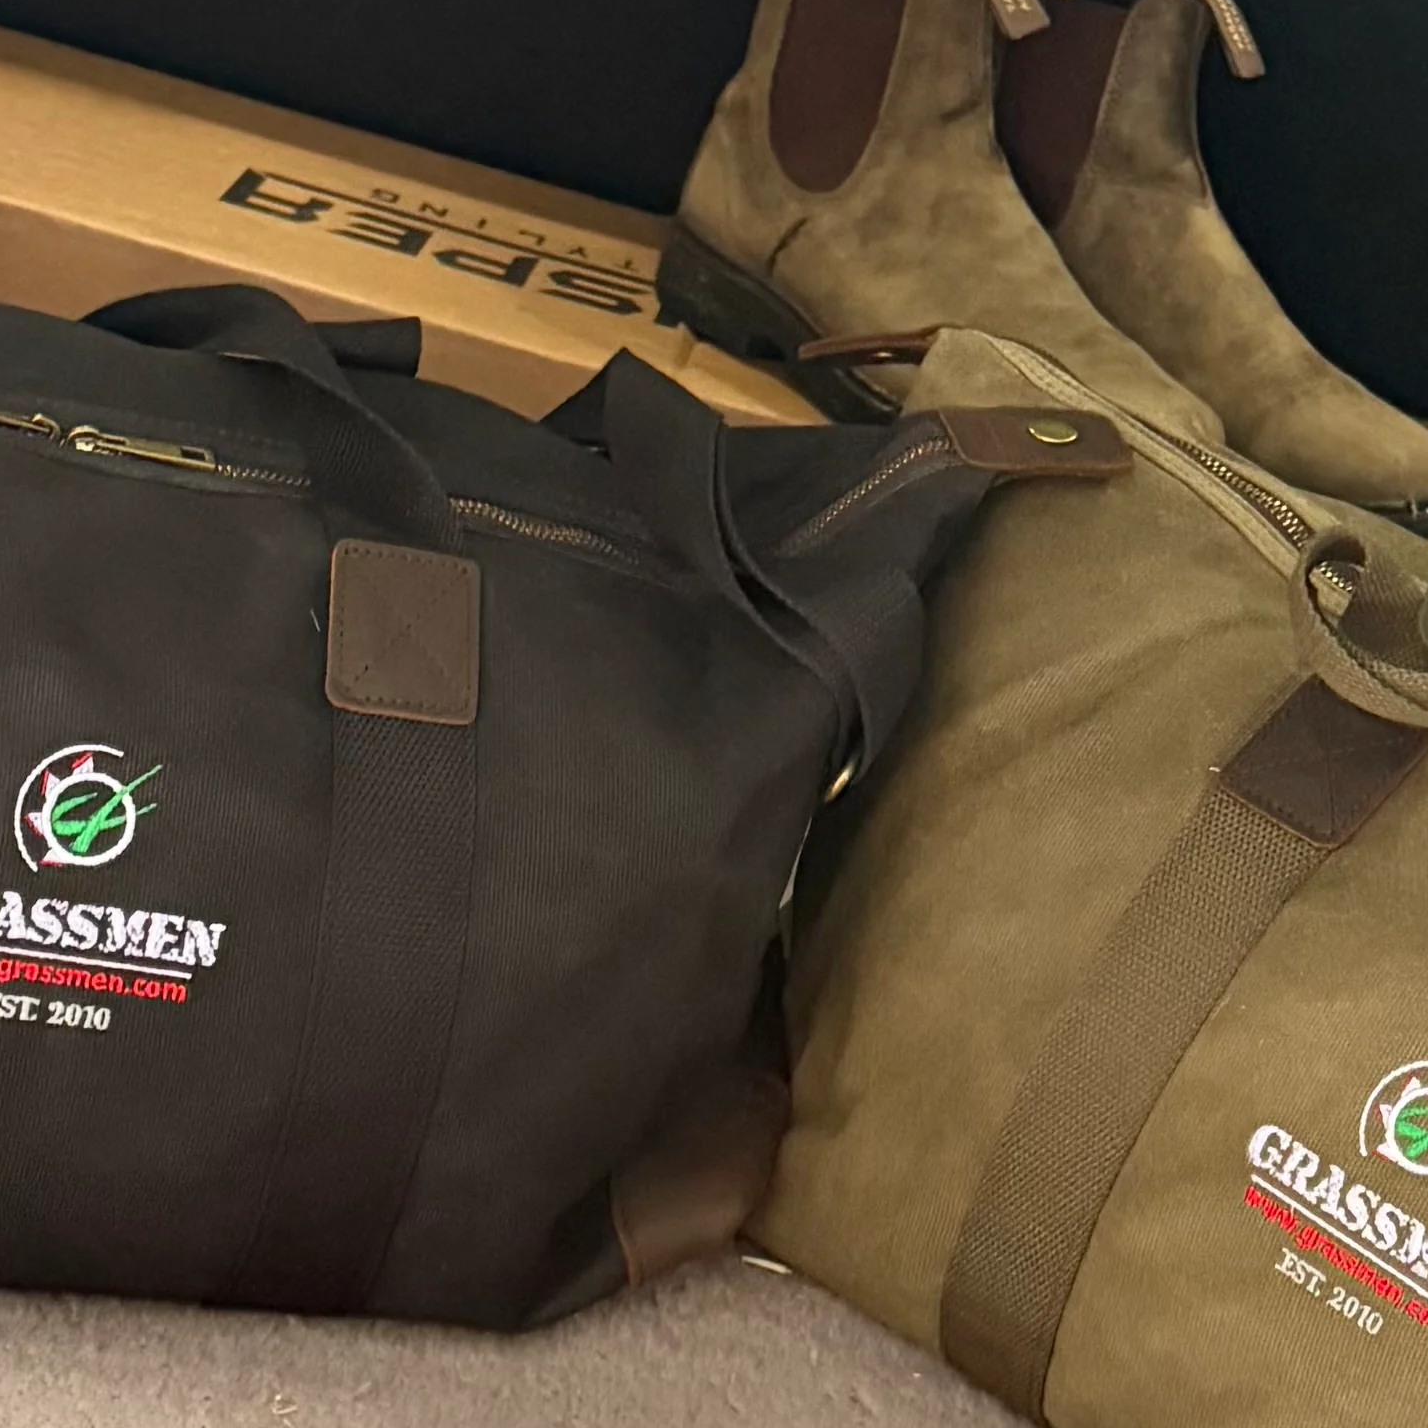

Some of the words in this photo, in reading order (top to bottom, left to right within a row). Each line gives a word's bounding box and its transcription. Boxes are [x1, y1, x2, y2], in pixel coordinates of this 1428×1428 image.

[370, 187, 641, 272] TYLING
[47, 1001, 111, 1031] 2010
[1274, 1248, 1326, 1298] EST.
[1326, 1287, 1384, 1335] 2010
